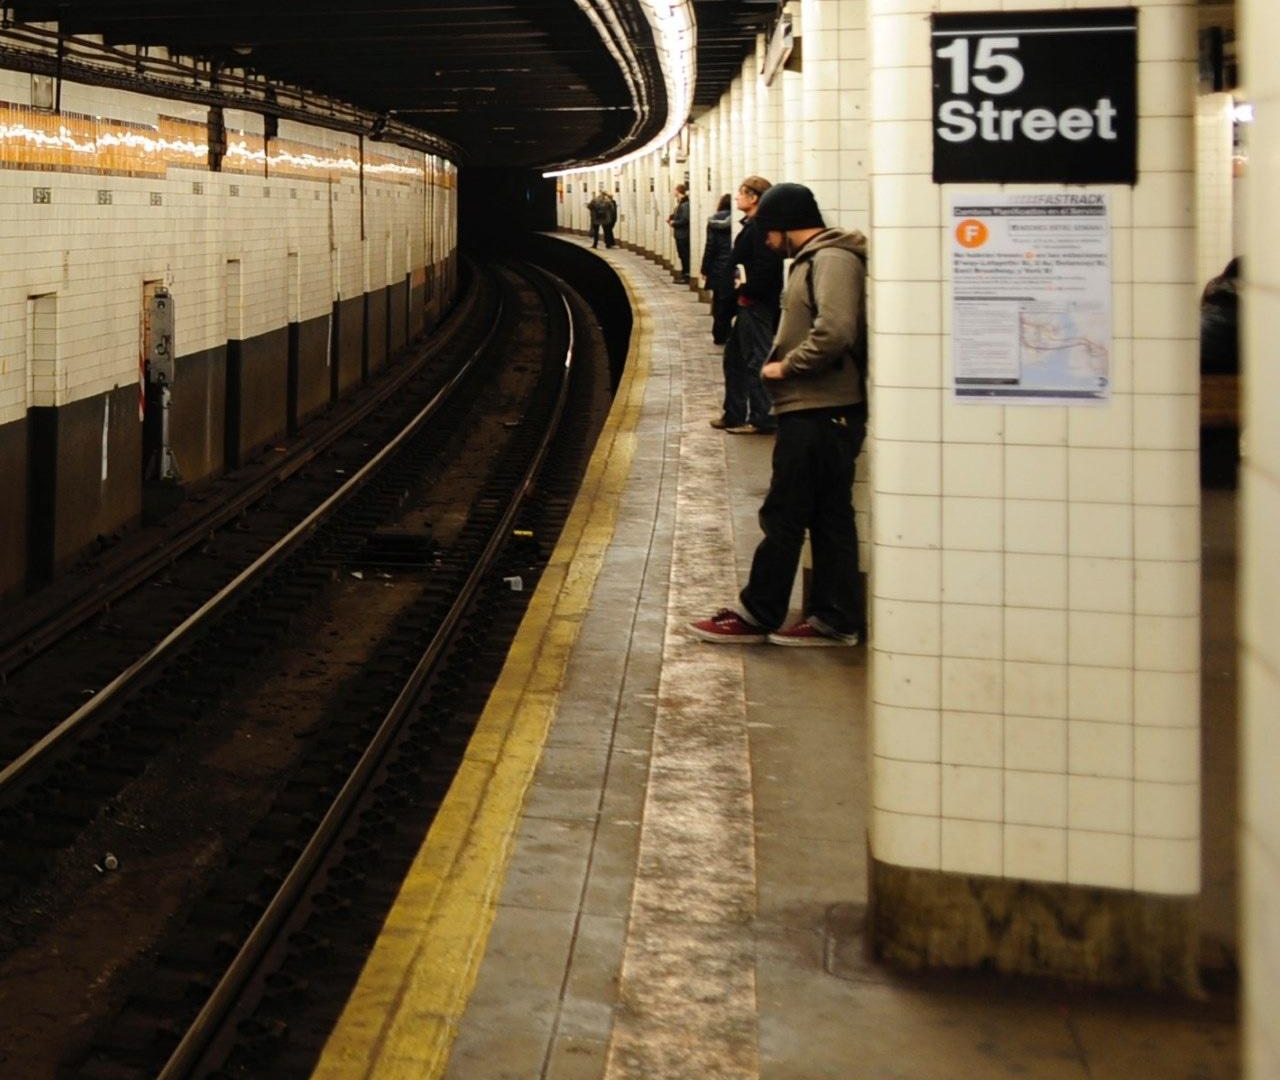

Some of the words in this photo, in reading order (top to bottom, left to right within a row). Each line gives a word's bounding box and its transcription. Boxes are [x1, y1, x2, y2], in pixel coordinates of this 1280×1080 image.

[936, 37, 1024, 95] 15
[937, 98, 1117, 142] Street
[965, 225, 979, 242] F
